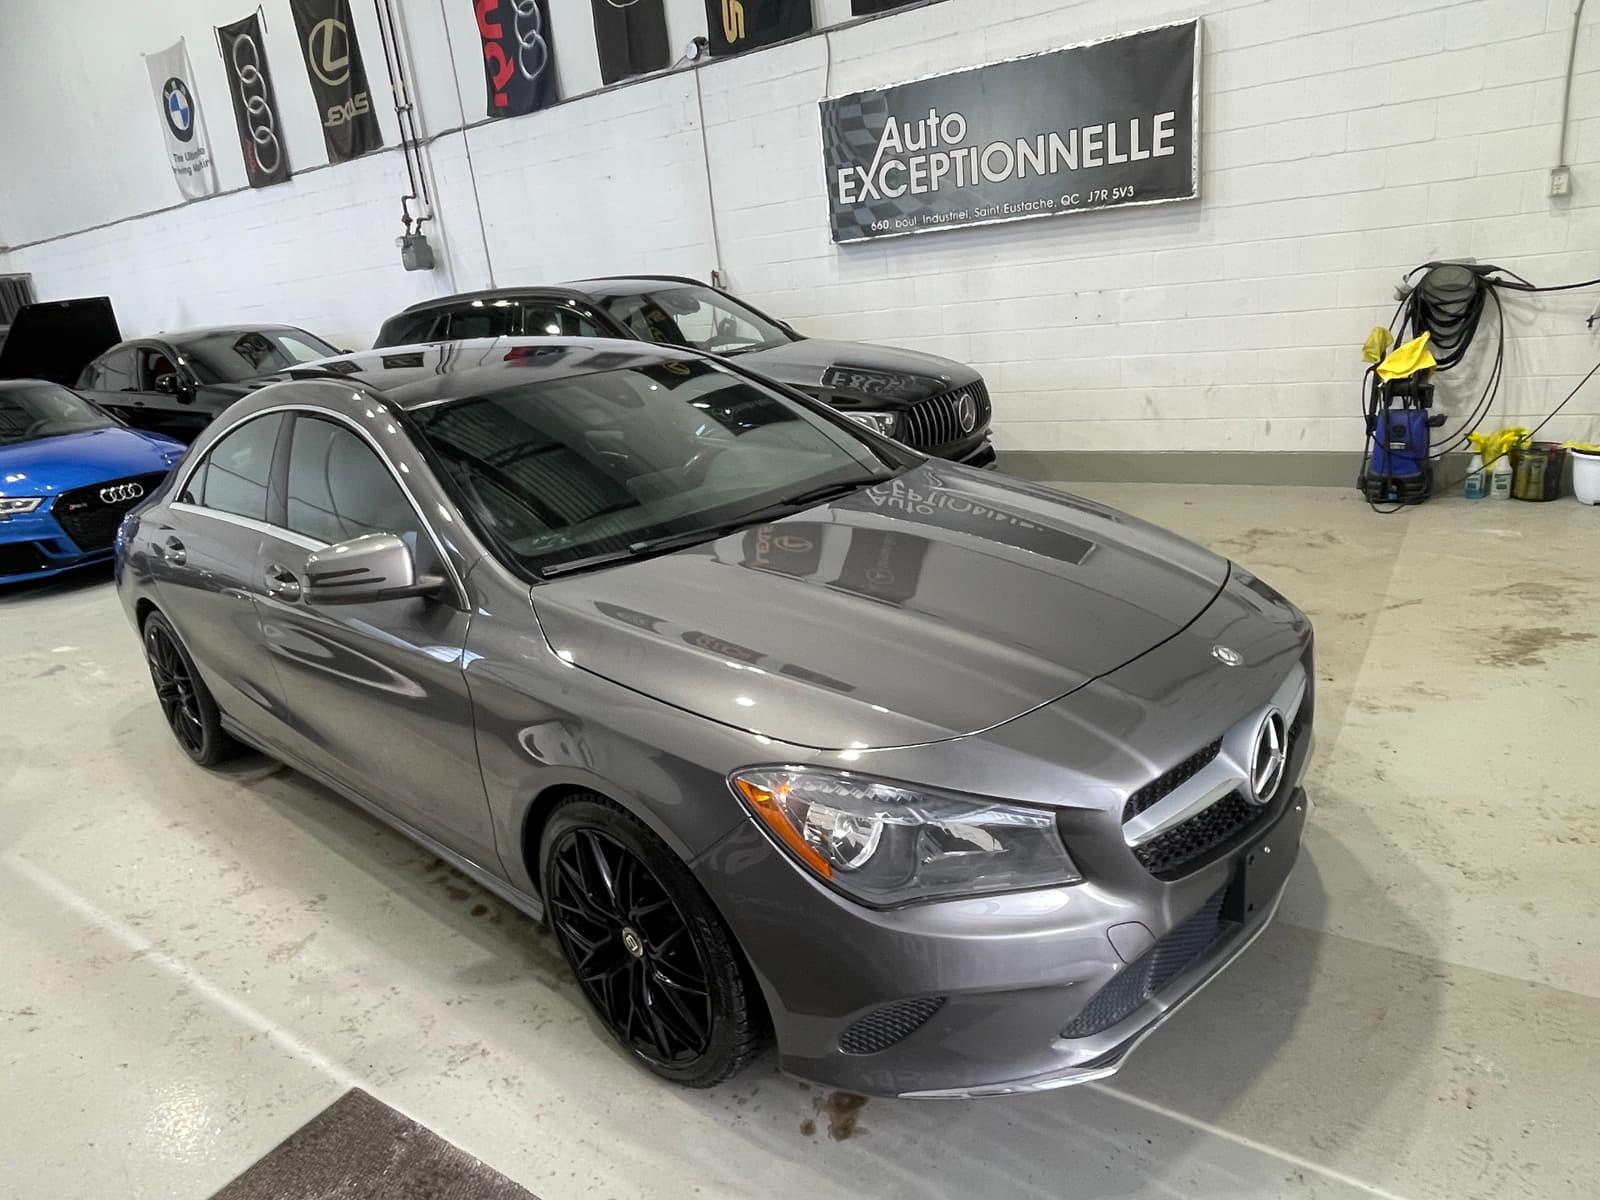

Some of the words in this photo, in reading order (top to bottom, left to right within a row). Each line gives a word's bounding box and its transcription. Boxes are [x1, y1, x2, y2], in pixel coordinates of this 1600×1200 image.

[878, 107, 968, 155] Auto
[838, 110, 1176, 205] EXCEPTIONNELLE
[1060, 193, 1080, 206] QC
[1087, 189, 1108, 202] J7R
[1112, 185, 1135, 199] 5V3
